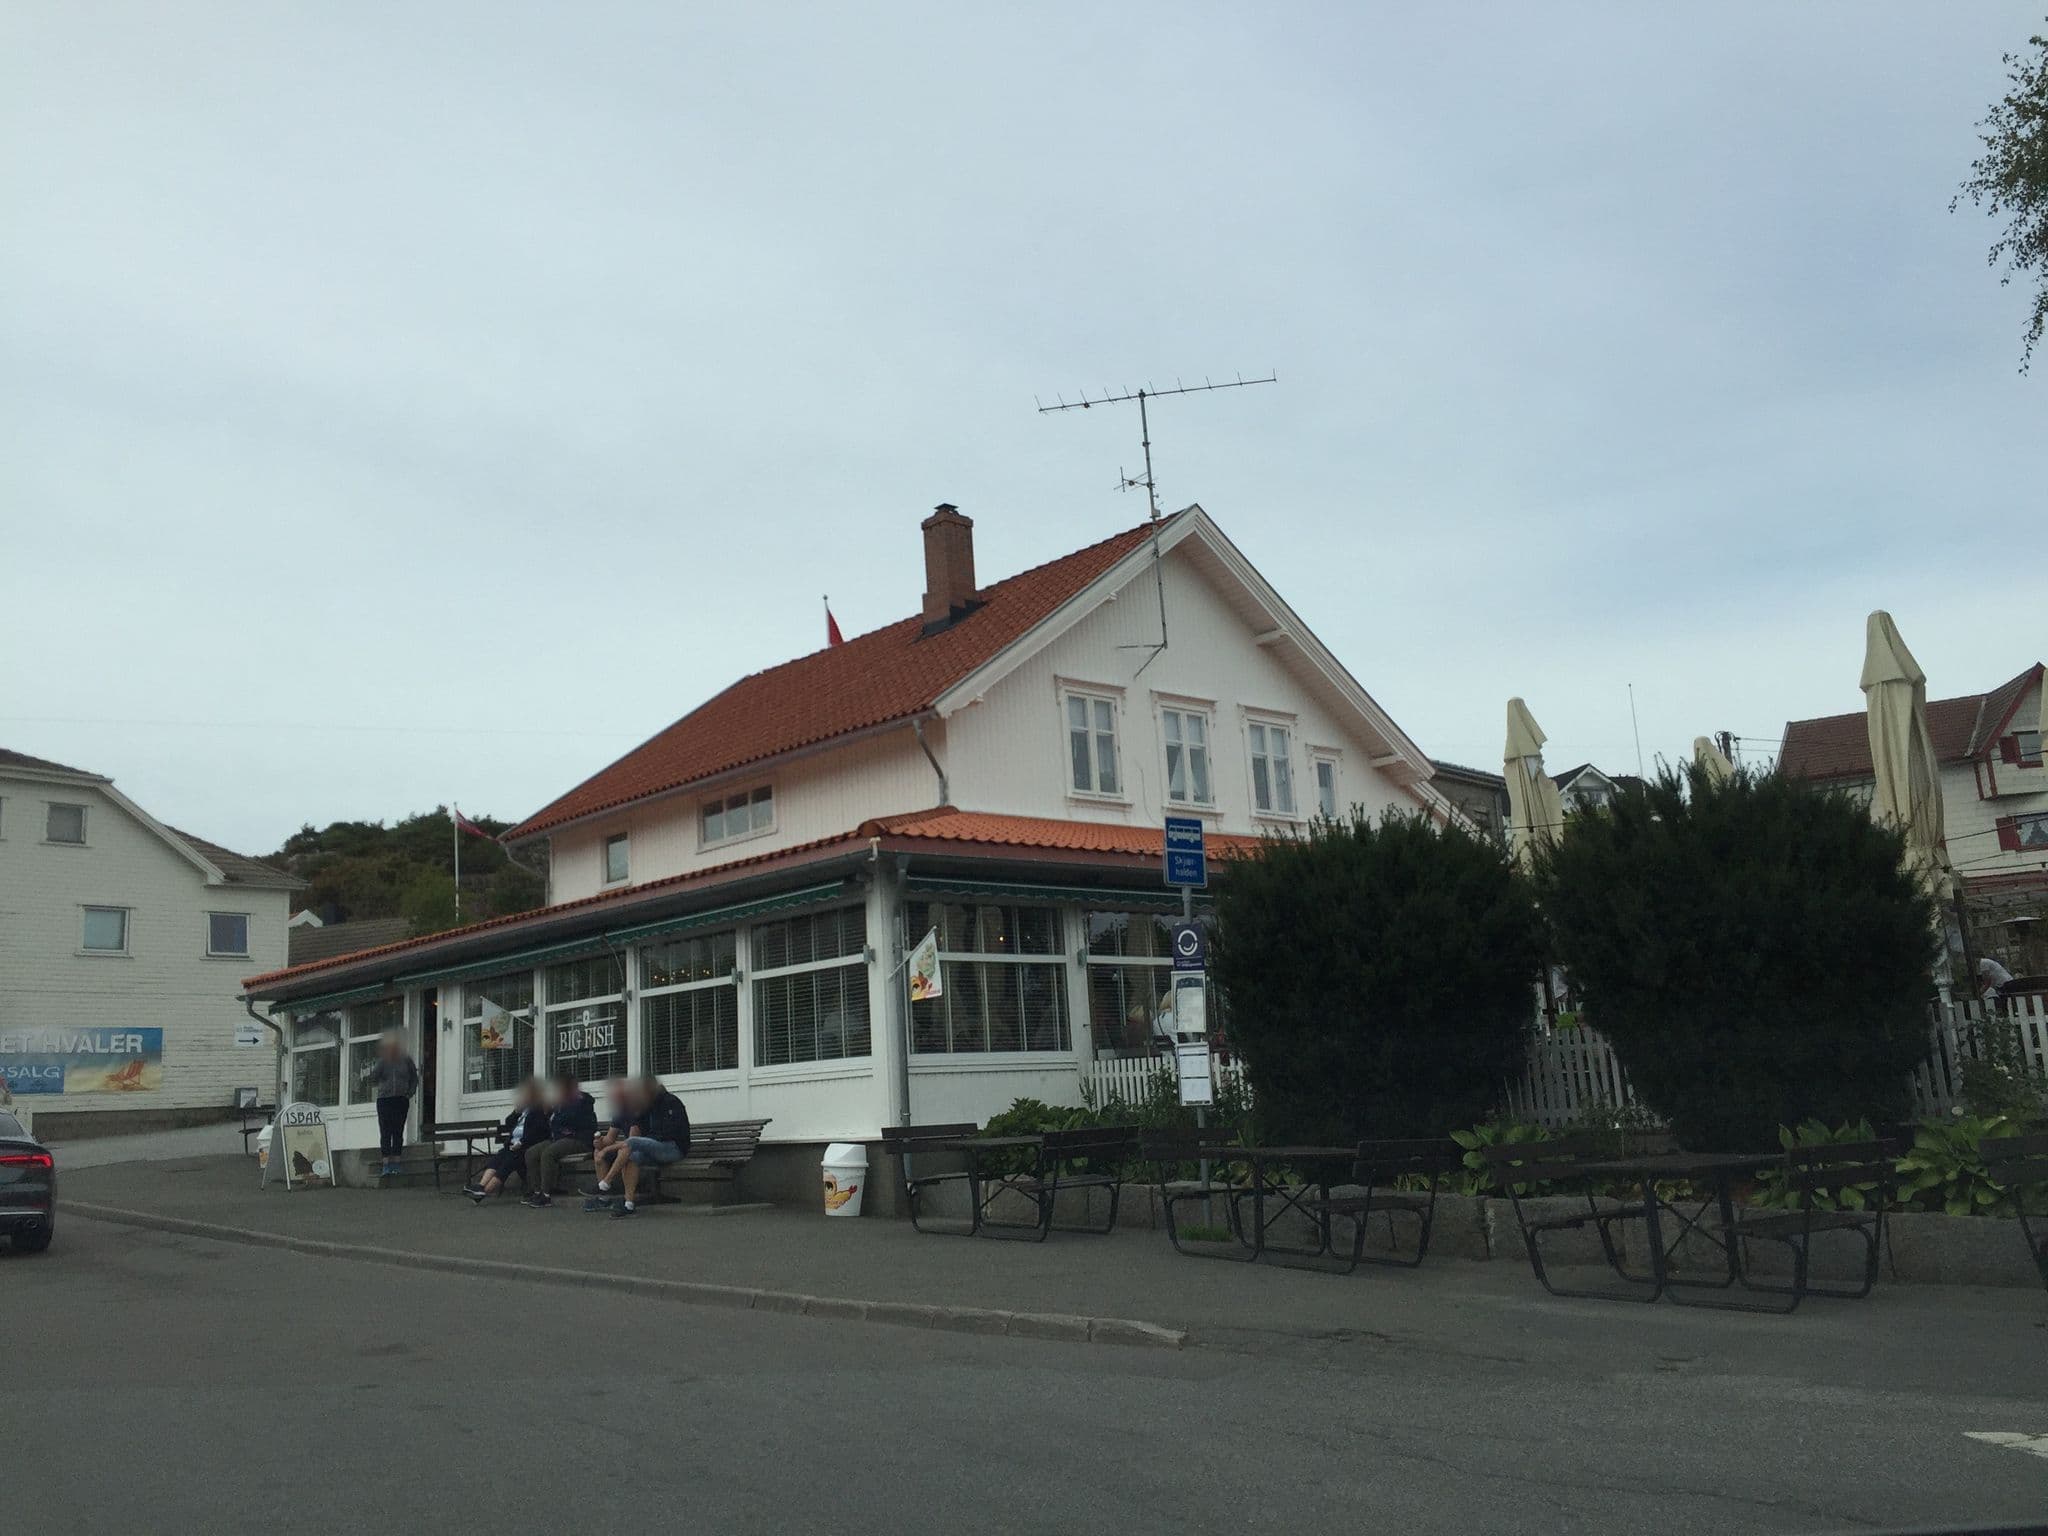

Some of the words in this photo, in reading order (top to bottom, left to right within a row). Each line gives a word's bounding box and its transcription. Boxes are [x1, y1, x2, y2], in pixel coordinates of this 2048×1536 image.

[43, 1033, 144, 1053] HVALER
[560, 1029, 581, 1052] BIG
[584, 1024, 615, 1049] FISH
[286, 1111, 322, 1124] ISBAR
